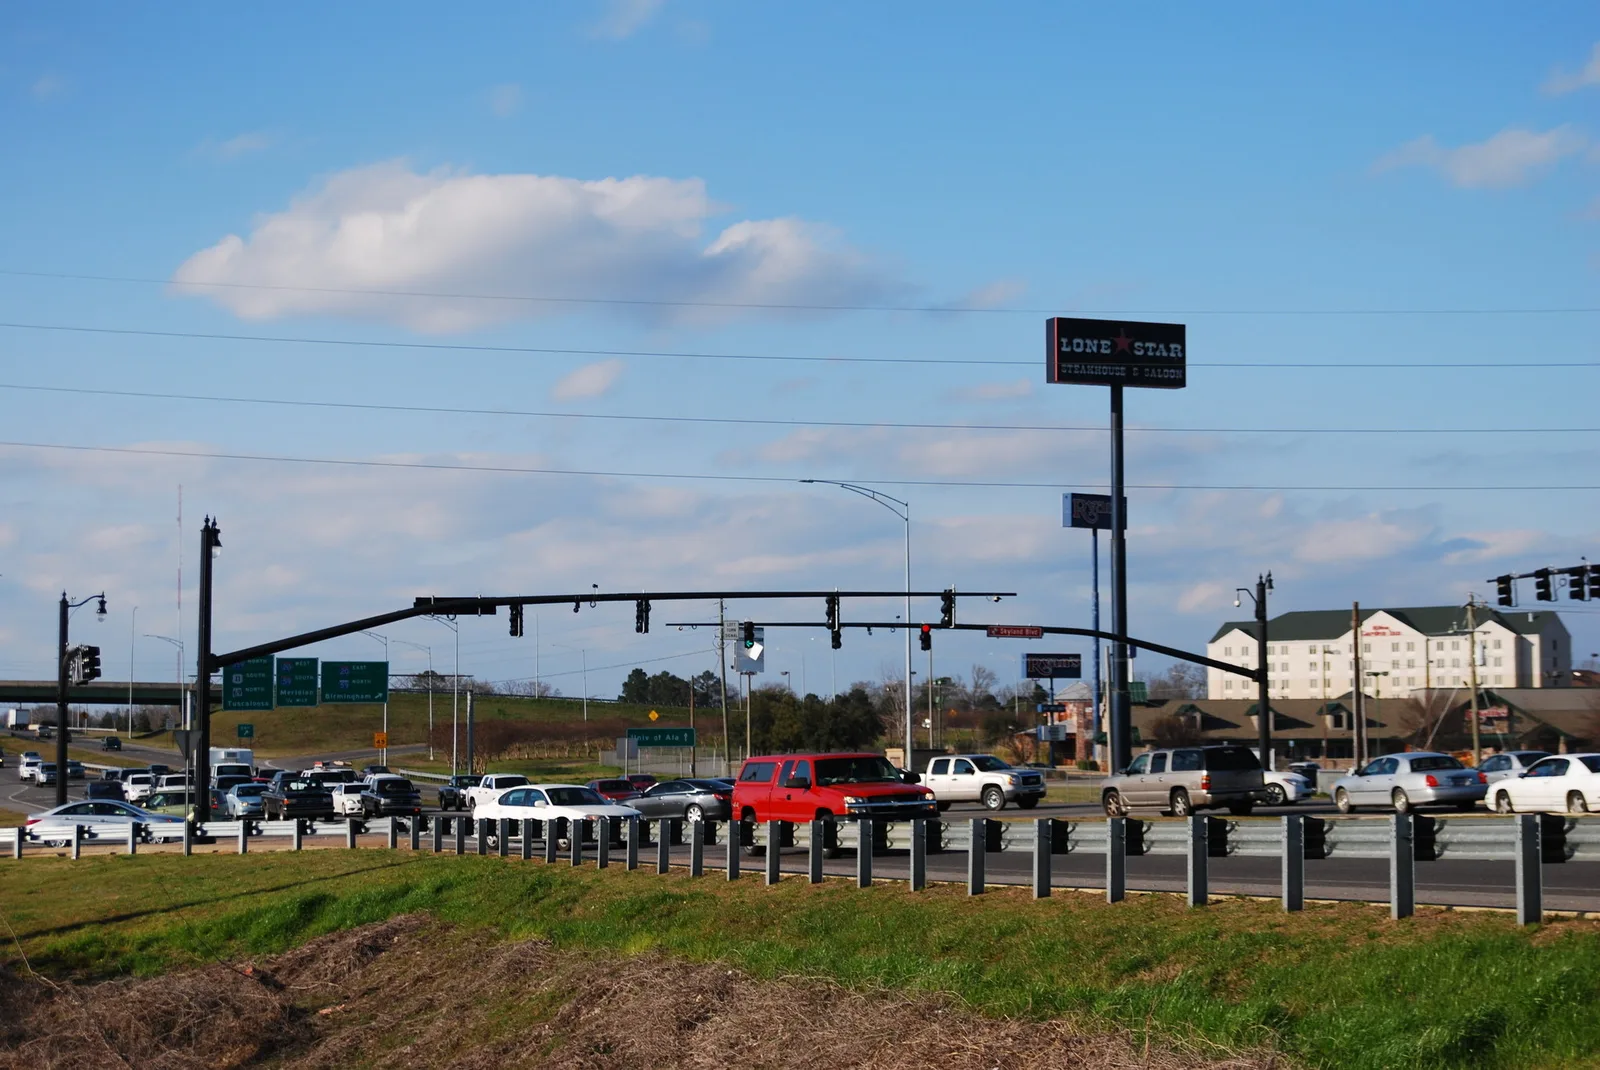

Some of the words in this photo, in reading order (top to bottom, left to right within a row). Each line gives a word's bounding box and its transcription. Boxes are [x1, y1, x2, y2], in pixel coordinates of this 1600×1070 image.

[1060, 338, 1112, 354] LONE
[1133, 341, 1183, 358] STAR
[1060, 364, 1126, 377] STEAKHOUSE
[1132, 367, 1139, 377] &
[1144, 367, 1183, 379] SALOON
[1000, 628, 1023, 636] Skyland
[325, 693, 371, 701] Birmingham
[653, 734, 662, 742] of
